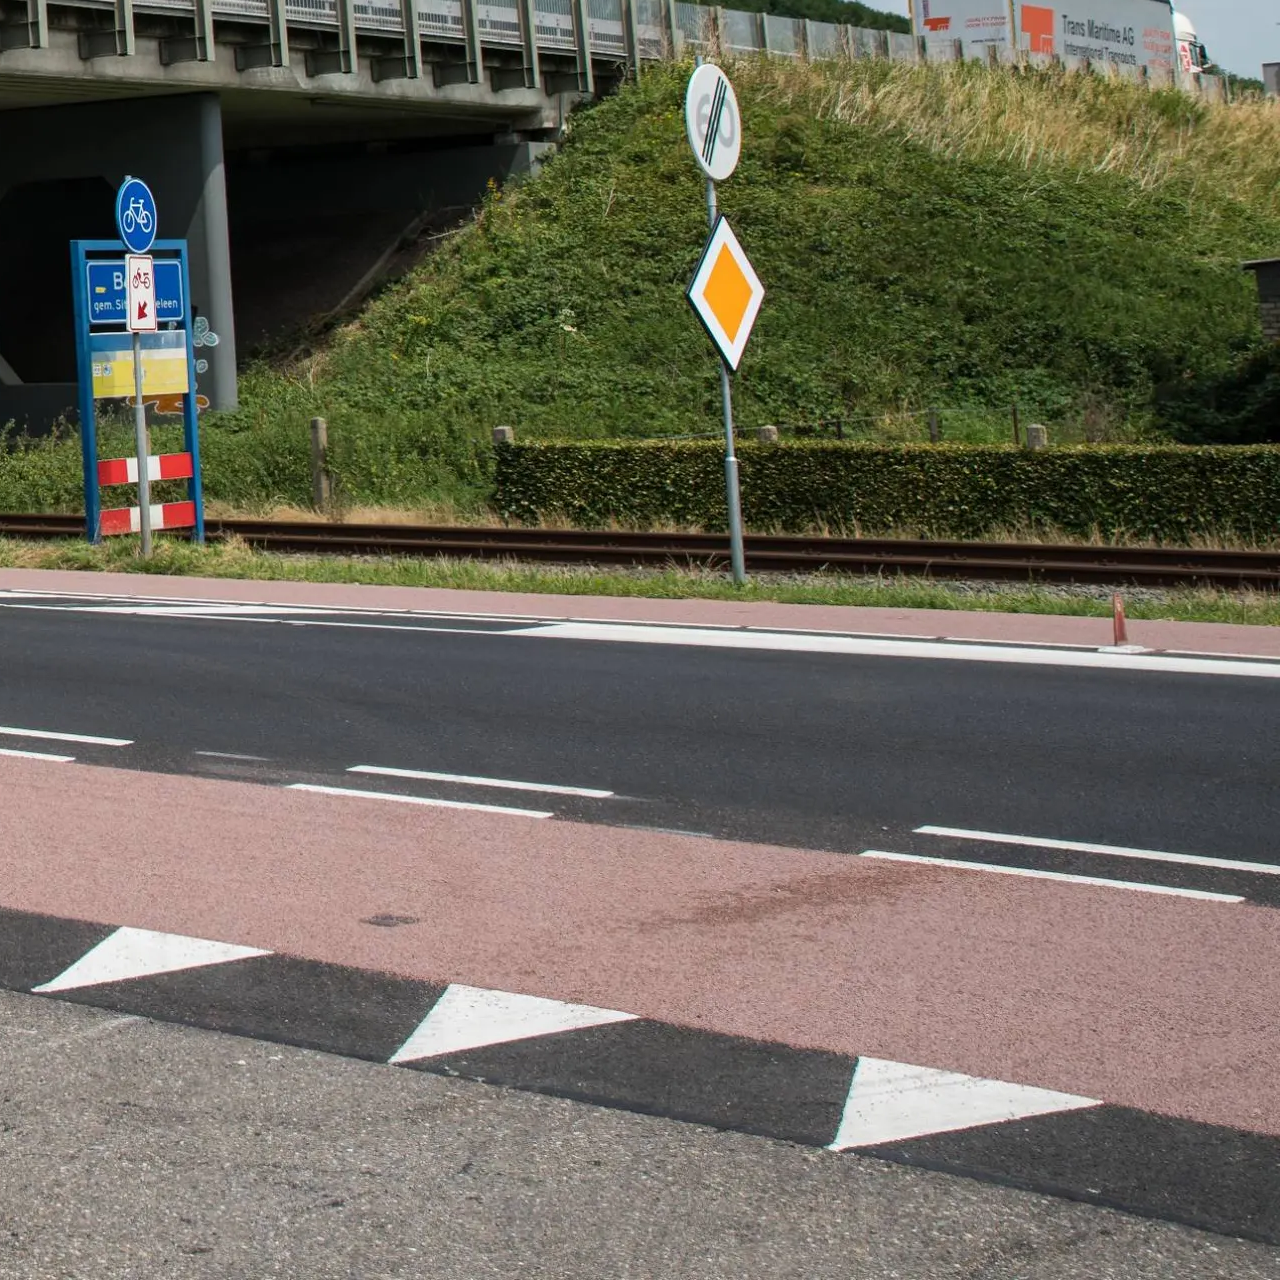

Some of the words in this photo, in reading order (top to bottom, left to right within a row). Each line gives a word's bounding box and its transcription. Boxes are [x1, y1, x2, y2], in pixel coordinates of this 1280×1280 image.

[1061, 14, 1085, 37] Trans
[1088, 20, 1121, 44] Maritime
[1122, 27, 1135, 46] AG
[696, 93, 735, 148] 60
[93, 301, 114, 314] gem.
